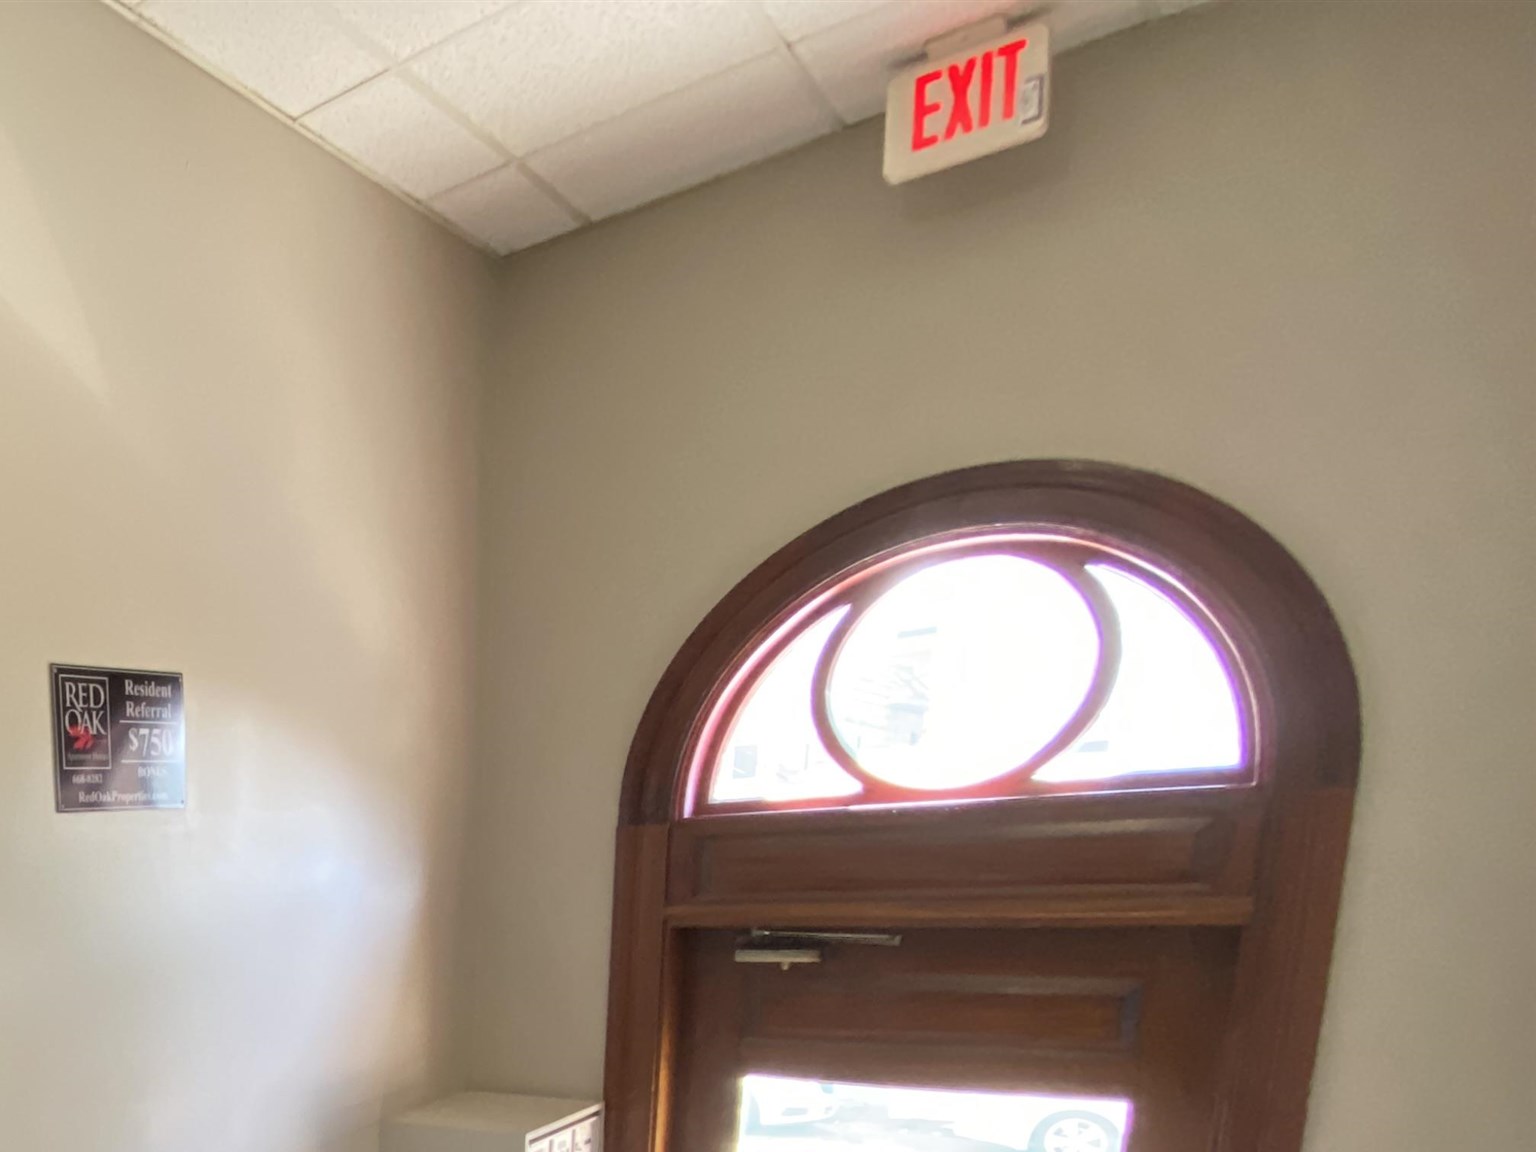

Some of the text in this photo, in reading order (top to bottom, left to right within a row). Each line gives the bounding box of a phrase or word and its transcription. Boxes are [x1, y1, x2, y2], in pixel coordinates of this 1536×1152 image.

[911, 38, 1028, 153] EXIT
[64, 681, 105, 710] RED
[125, 679, 172, 697] Resident
[65, 708, 107, 735] OAK
[125, 701, 172, 718] Referral
[128, 727, 174, 757] $750
